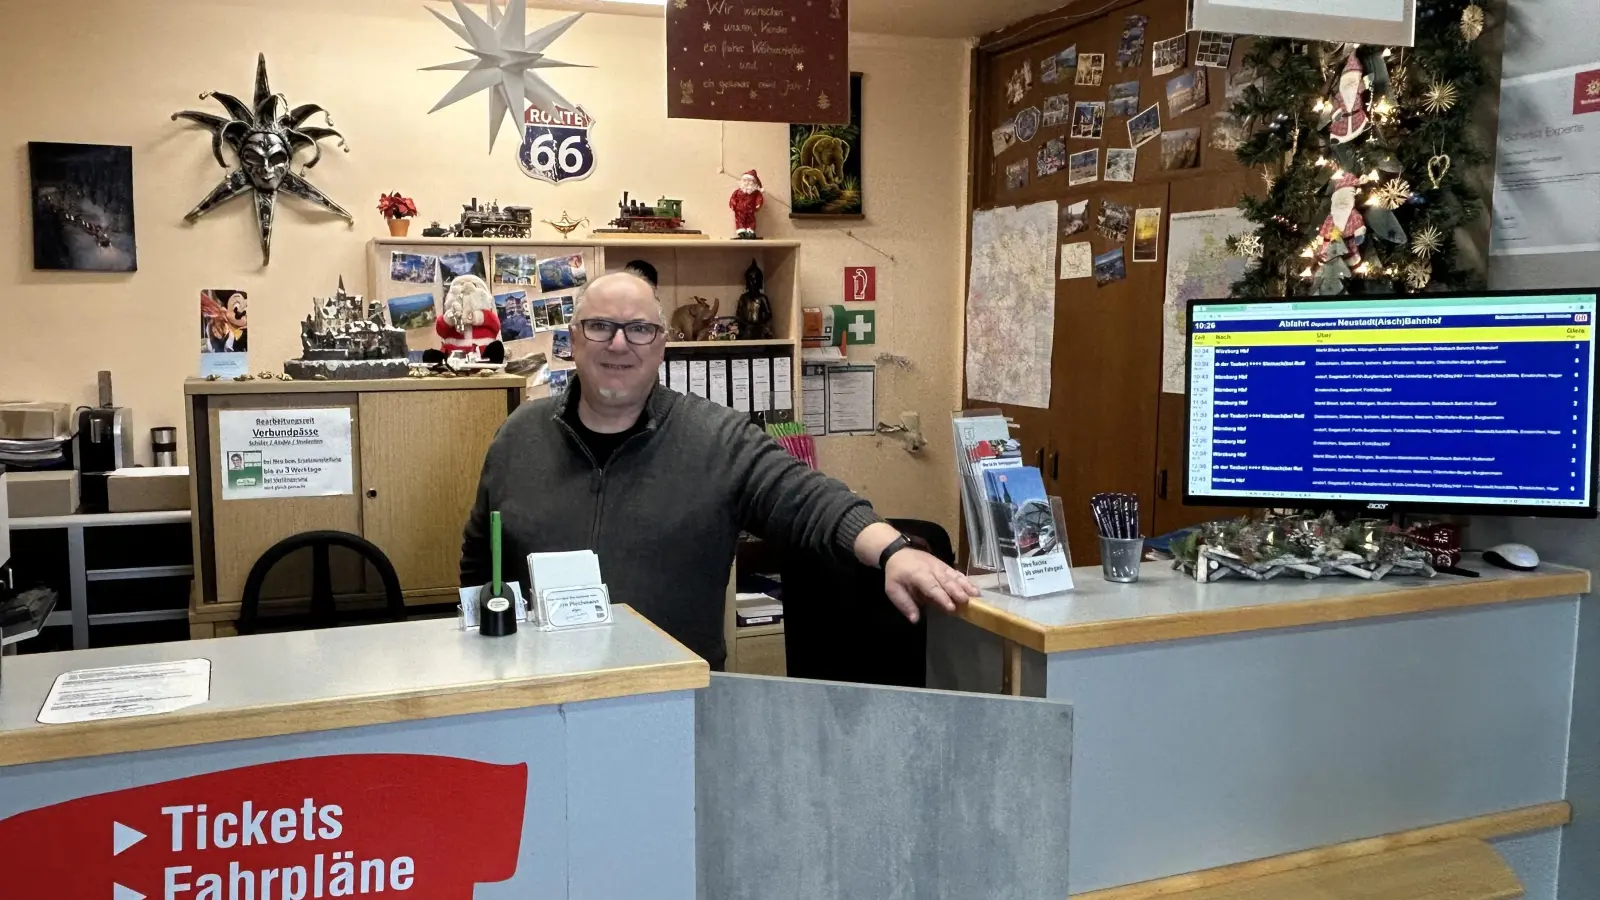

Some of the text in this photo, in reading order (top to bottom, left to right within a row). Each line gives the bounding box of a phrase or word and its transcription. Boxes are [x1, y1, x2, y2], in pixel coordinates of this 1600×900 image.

[707, 0, 734, 16] Wir
[739, 61, 758, 70] und
[1546, 124, 1584, 138] Experte
[530, 134, 584, 174] 66
[1195, 322, 1216, 330] 10:26
[1278, 320, 1310, 328] Abfahrt
[256, 417, 315, 426] Bearbeitungszeit
[252, 428, 319, 438] Verbundpässe
[162, 798, 343, 852] Tickets
[164, 851, 414, 900] Fahrpläne
